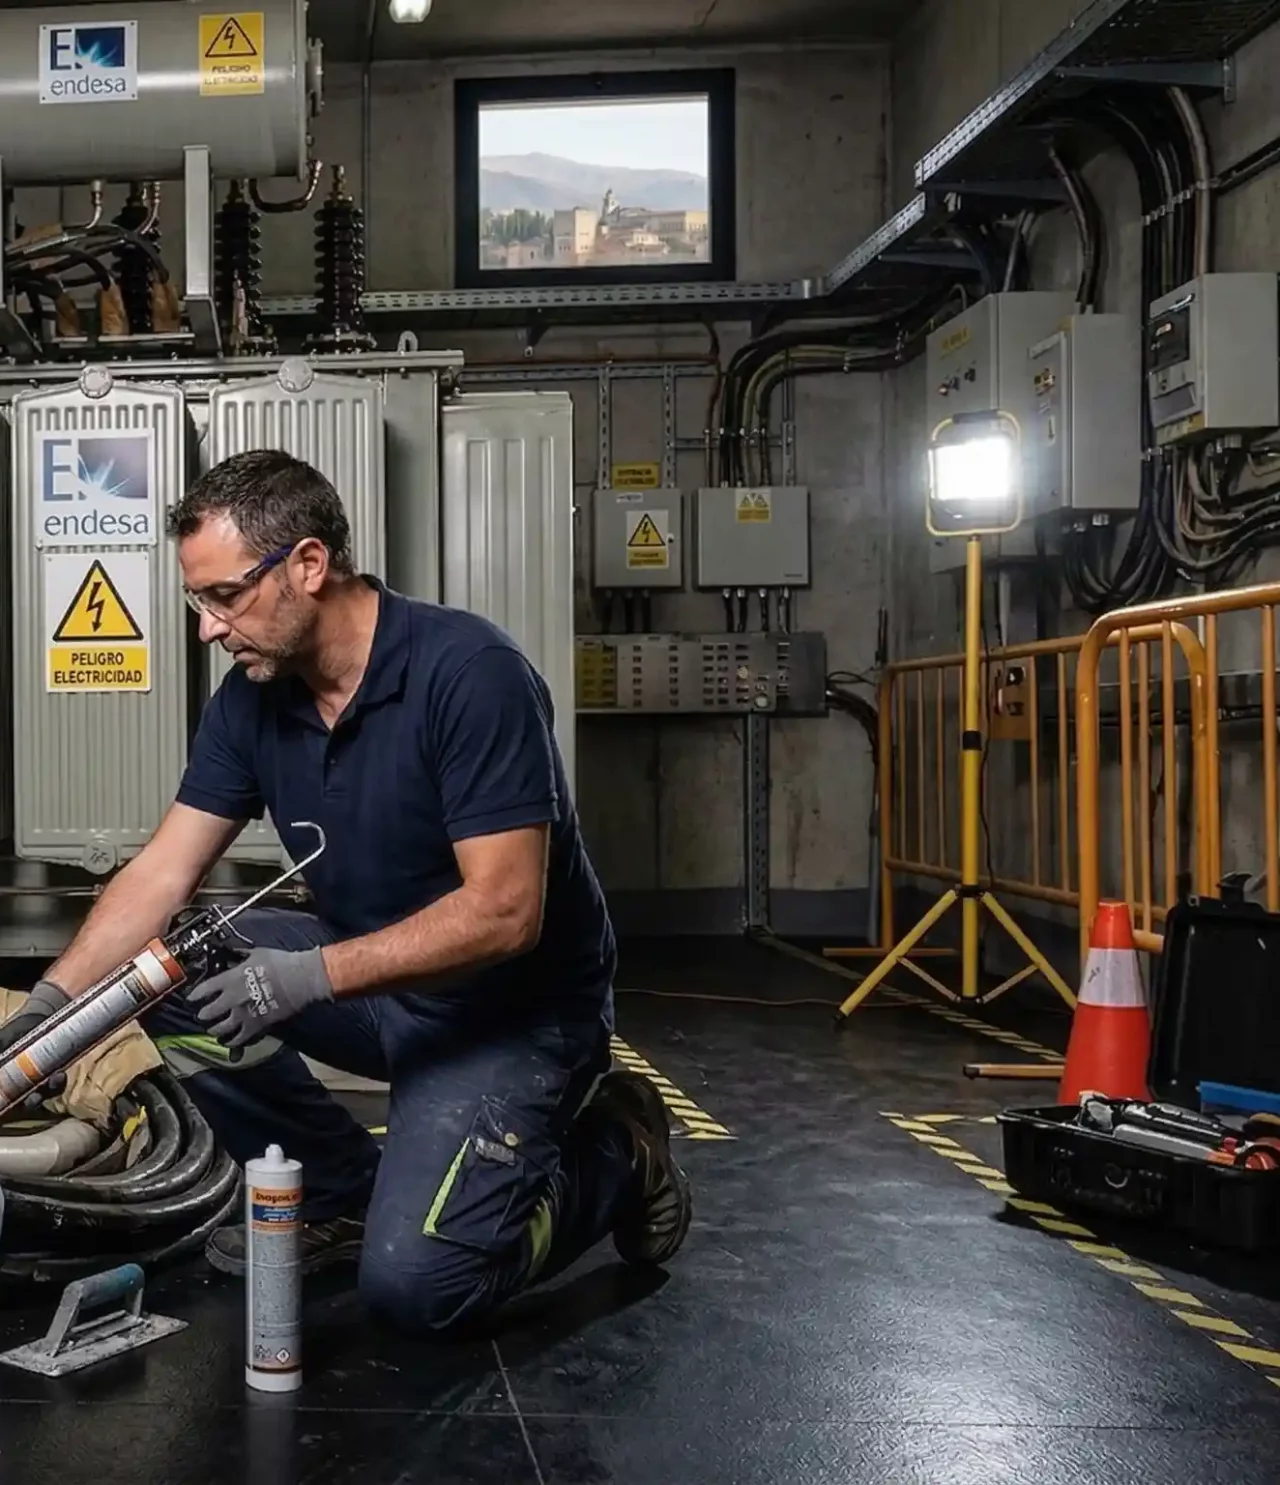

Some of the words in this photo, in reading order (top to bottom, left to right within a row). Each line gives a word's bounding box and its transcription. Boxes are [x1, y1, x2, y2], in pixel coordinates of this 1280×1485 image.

[50, 74, 126, 96] endesa
[44, 508, 149, 536] endesa
[71, 652, 124, 666] PELIGRO
[54, 669, 142, 684] ELECTRICIDAD
